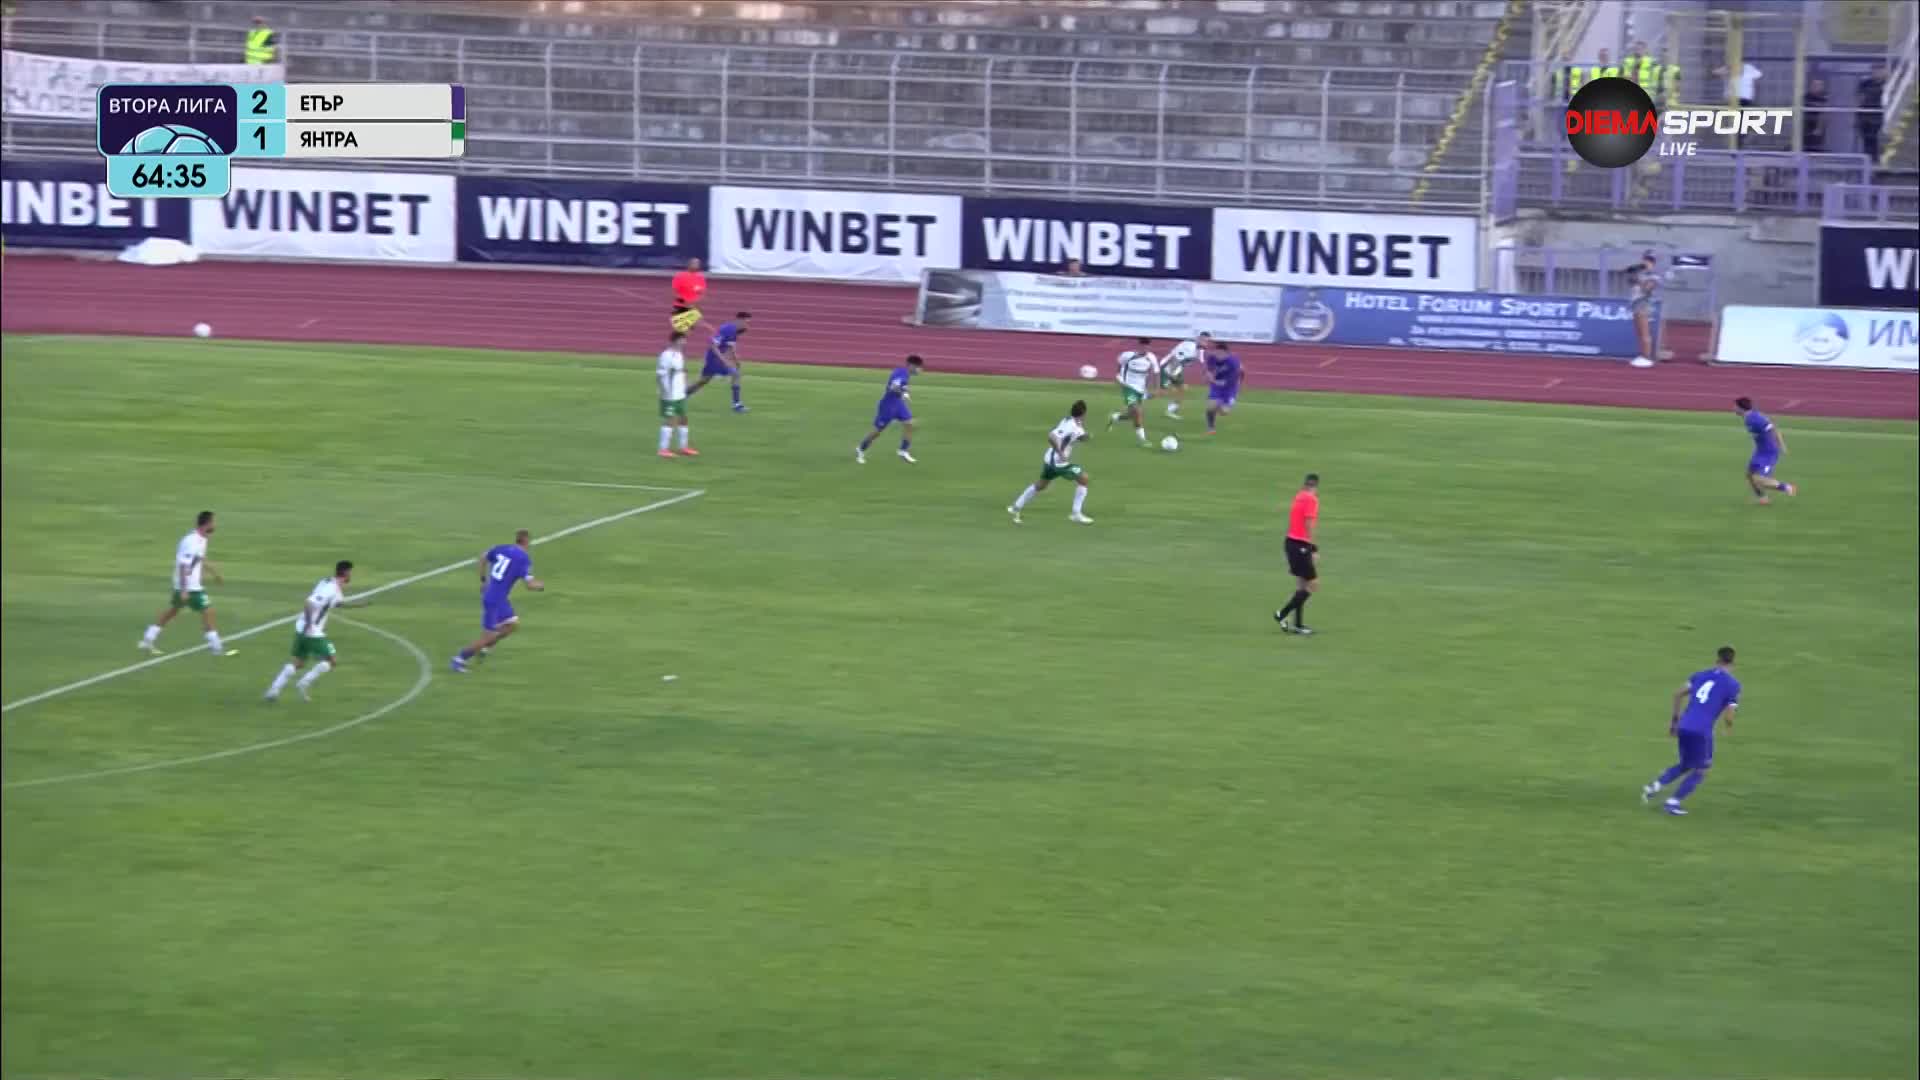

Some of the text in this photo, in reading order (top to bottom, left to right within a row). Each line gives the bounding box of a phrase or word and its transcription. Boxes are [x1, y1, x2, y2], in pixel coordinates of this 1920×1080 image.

[2, 180, 158, 228] INBET
[220, 189, 430, 236] WINBET
[480, 196, 689, 246] WINBET
[735, 207, 937, 256] WINBET
[982, 217, 1192, 269] WINBET
[1240, 229, 1450, 278] WINBET
[1345, 291, 1411, 311] HOTEL
[1418, 295, 1493, 313] FORUM
[1500, 299, 1570, 317] SPORT
[1576, 302, 1657, 322] PALA
[492, 554, 512, 580] 21
[1696, 680, 1715, 704] 4
